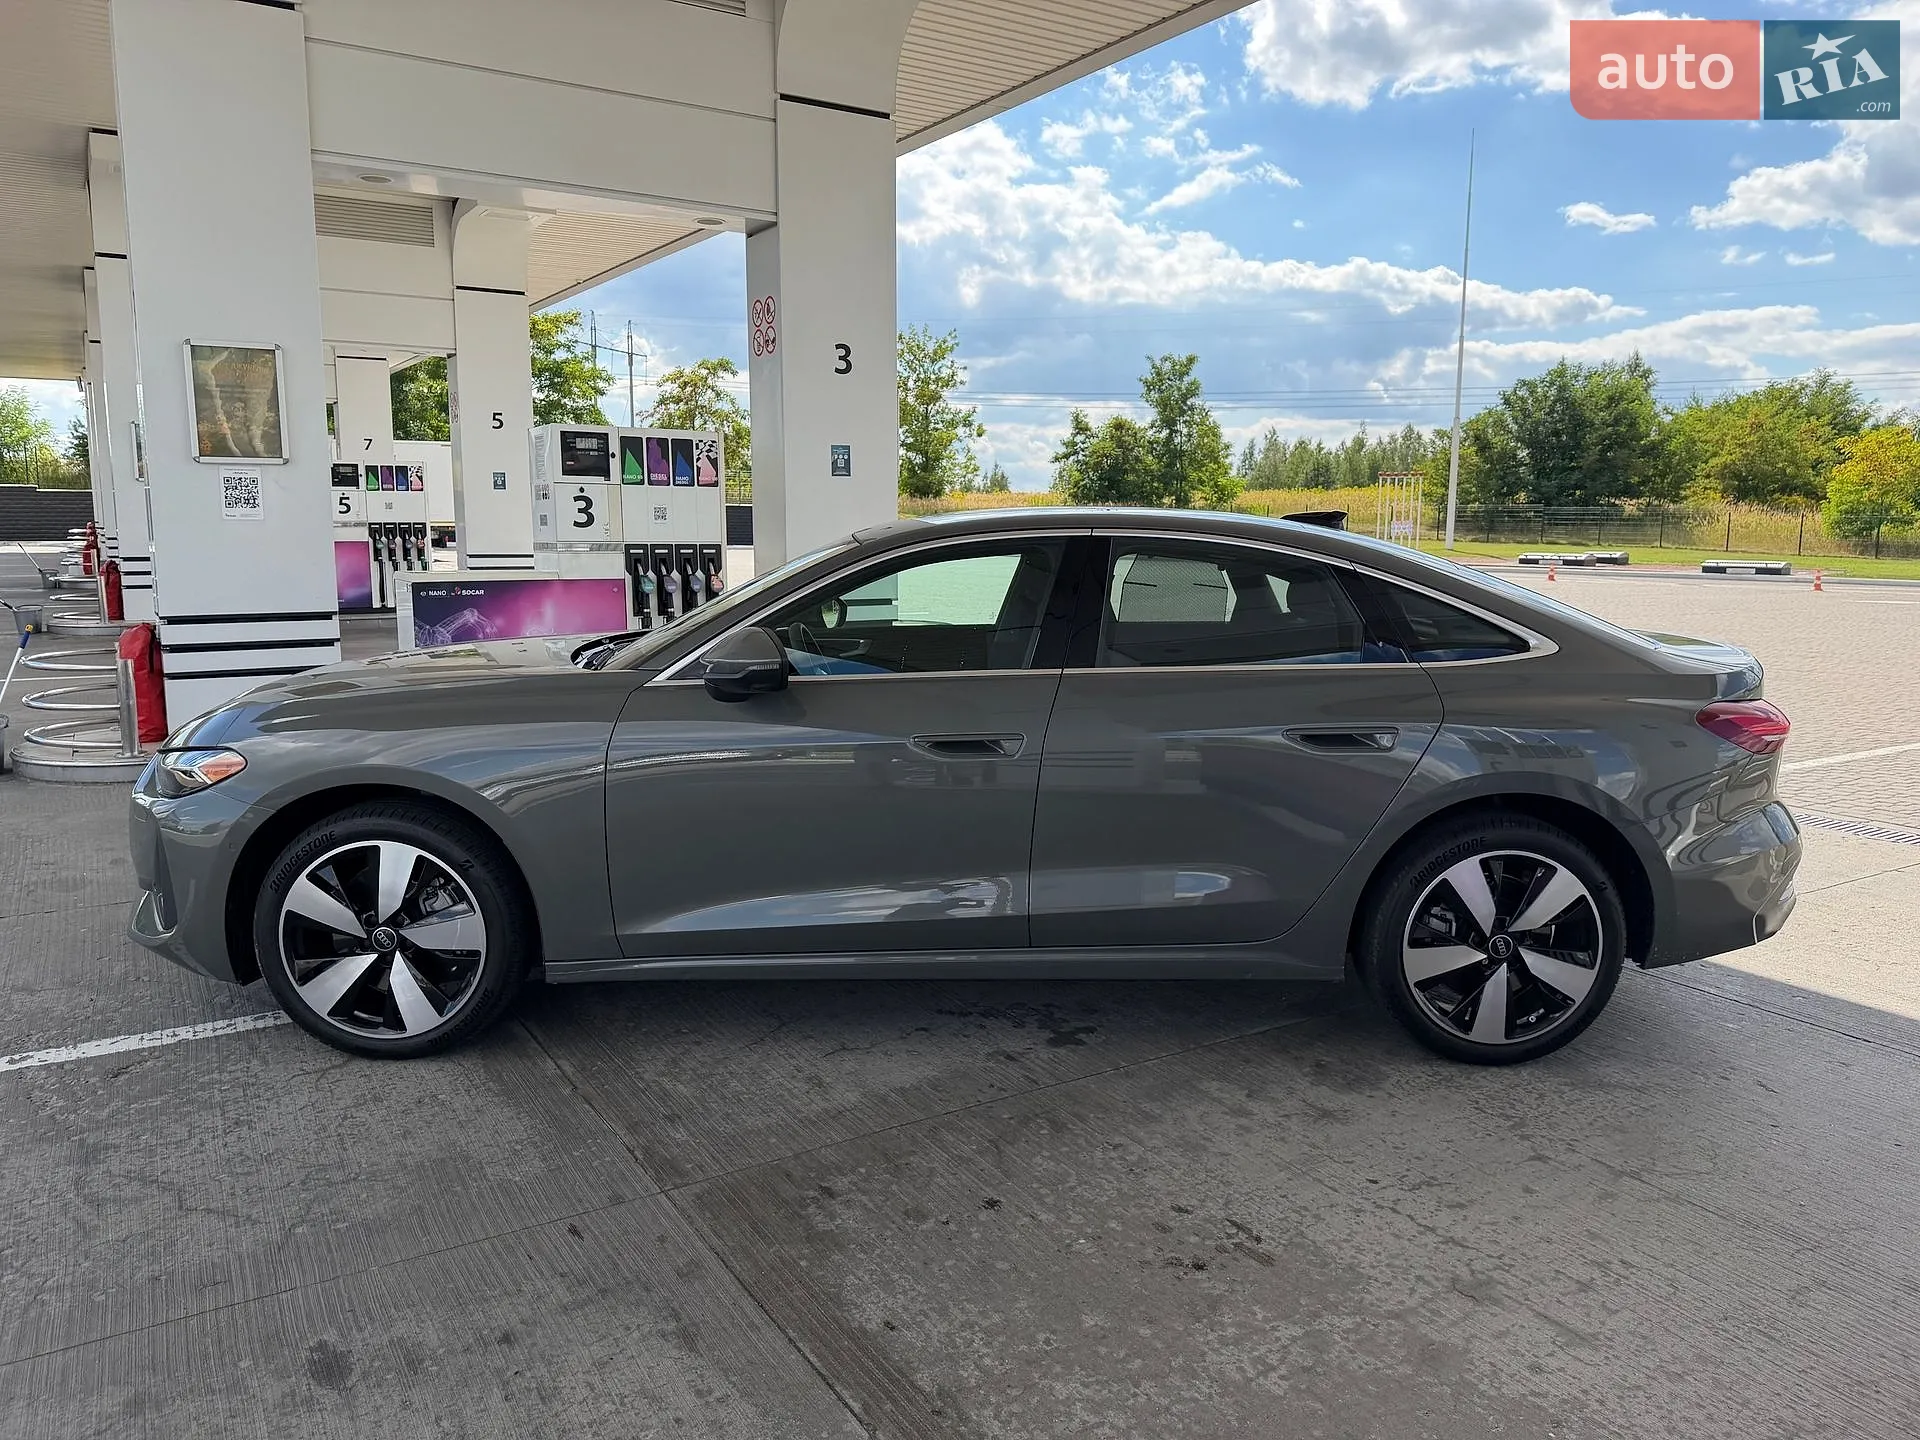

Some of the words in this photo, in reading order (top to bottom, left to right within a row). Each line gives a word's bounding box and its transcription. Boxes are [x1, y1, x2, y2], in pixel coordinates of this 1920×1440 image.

[834, 343, 853, 375] 3
[492, 412, 504, 430] 5
[363, 438, 373, 451] 7
[338, 496, 351, 514] 5
[572, 495, 595, 529] 3
[270, 830, 337, 893] BRIDGESTONE
[1409, 836, 1488, 889] BRIDGESTONE
